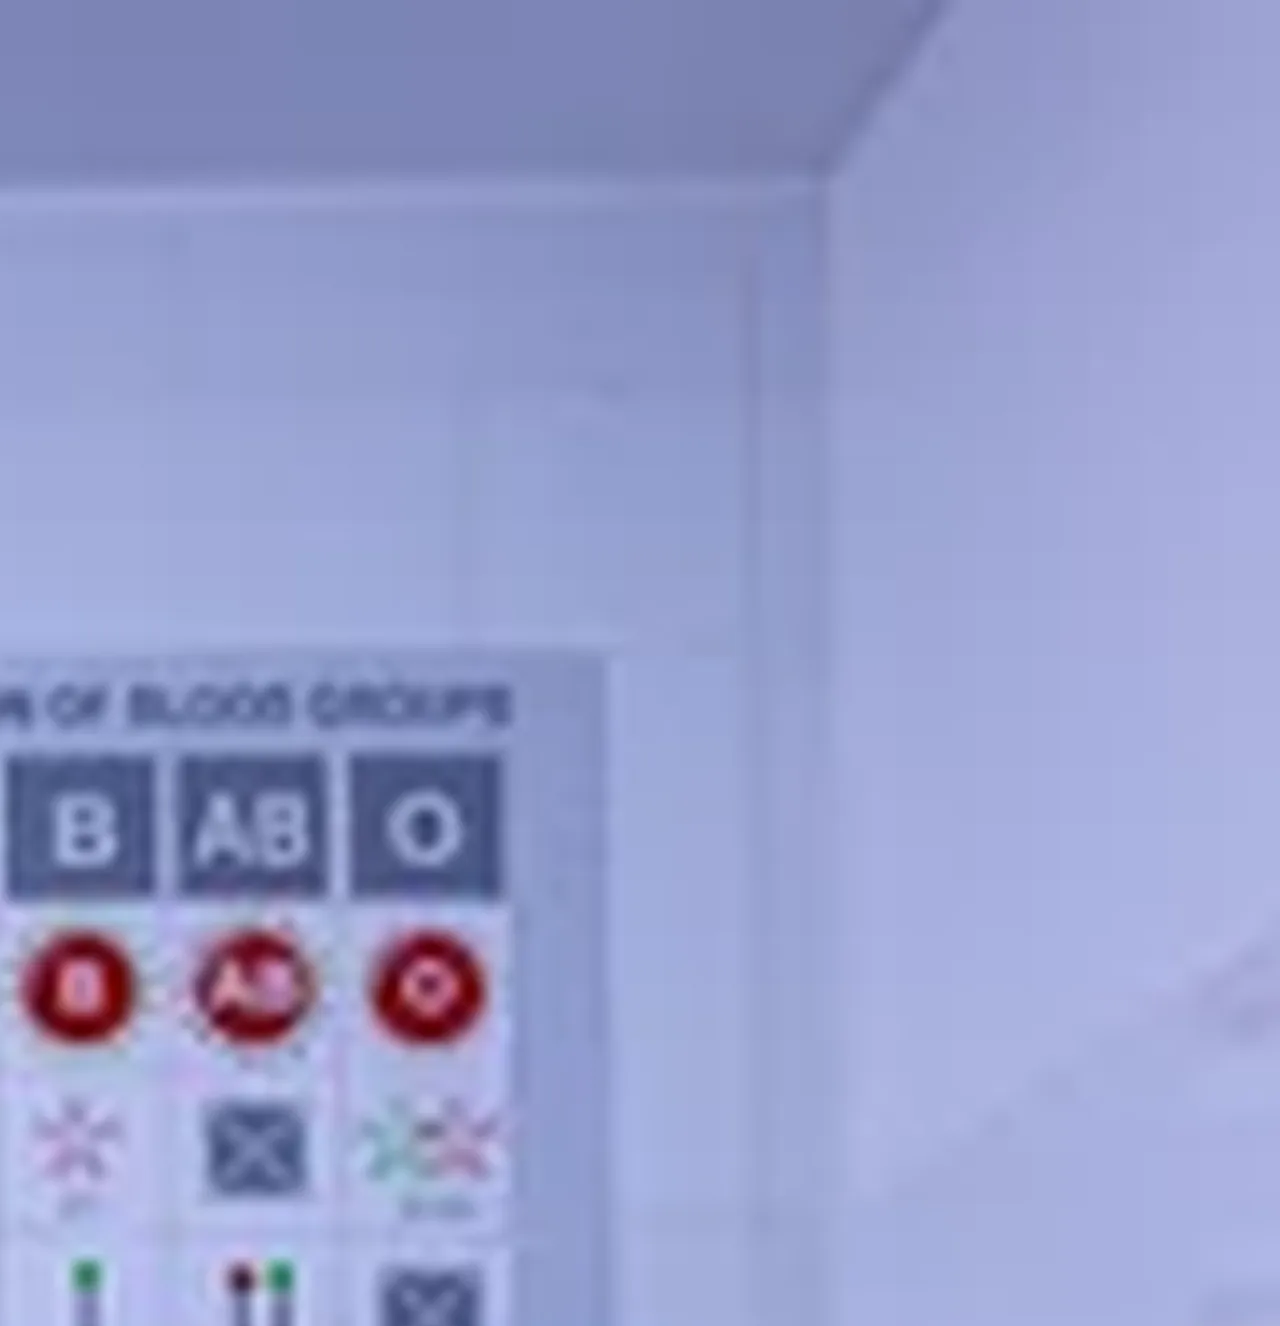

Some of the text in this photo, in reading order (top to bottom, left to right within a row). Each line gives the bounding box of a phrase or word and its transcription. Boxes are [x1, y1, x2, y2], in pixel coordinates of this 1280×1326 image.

[44, 682, 112, 732] OF
[126, 681, 294, 732] BLOOD
[305, 681, 516, 732] GROUPS
[52, 790, 118, 869] B
[192, 790, 312, 869] AB
